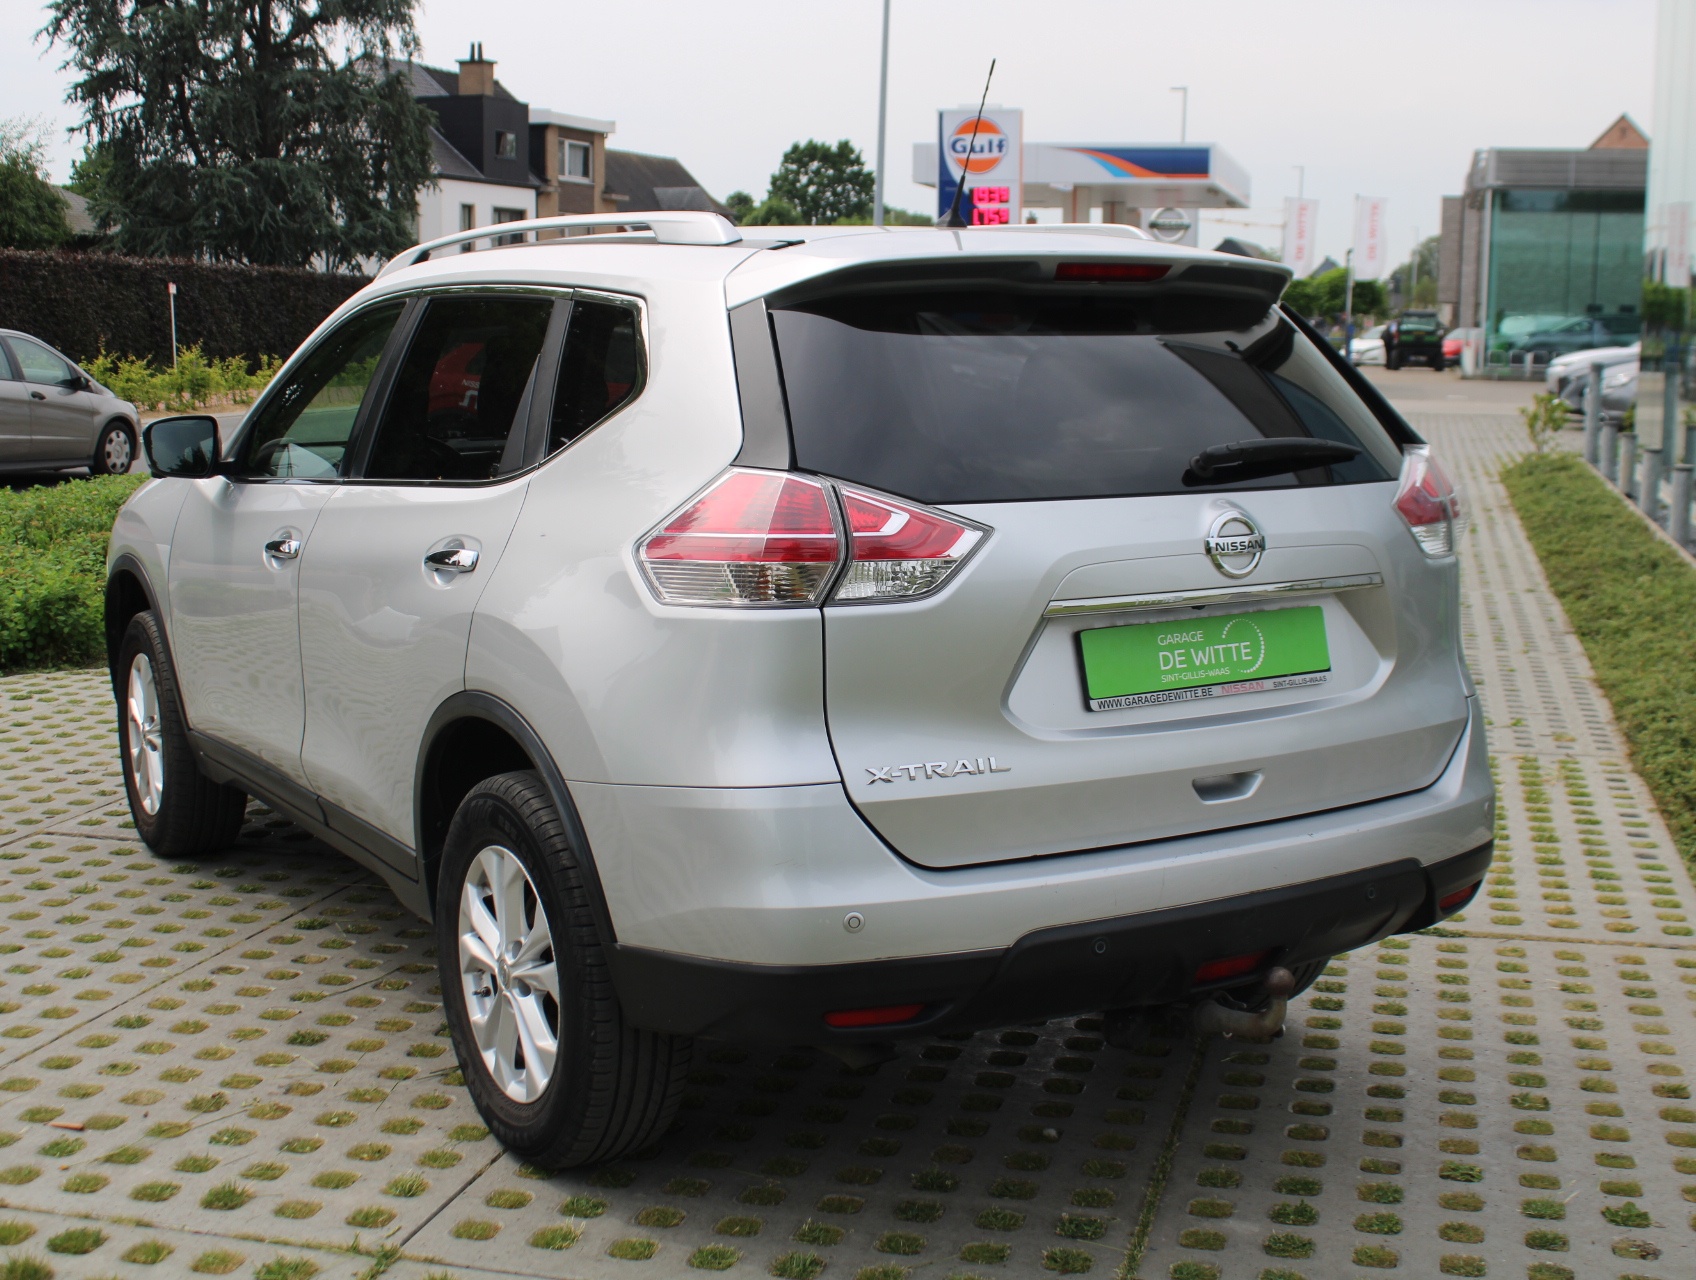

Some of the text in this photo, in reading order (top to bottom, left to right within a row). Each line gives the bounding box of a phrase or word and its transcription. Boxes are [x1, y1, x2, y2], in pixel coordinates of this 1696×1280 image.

[951, 137, 1006, 154] Gulf
[1215, 539, 1263, 552] NISSAN
[1157, 630, 1204, 646] GARAGE
[1159, 641, 1253, 670] DE WITTE
[1161, 667, 1230, 683] SINT-GILLIS-WAAS
[1097, 675, 1328, 710] WWW.GARAGEDEWITTE.BE NISSAN SINT-GILLIS-WAAS
[865, 756, 1012, 785] X-TRAIL
